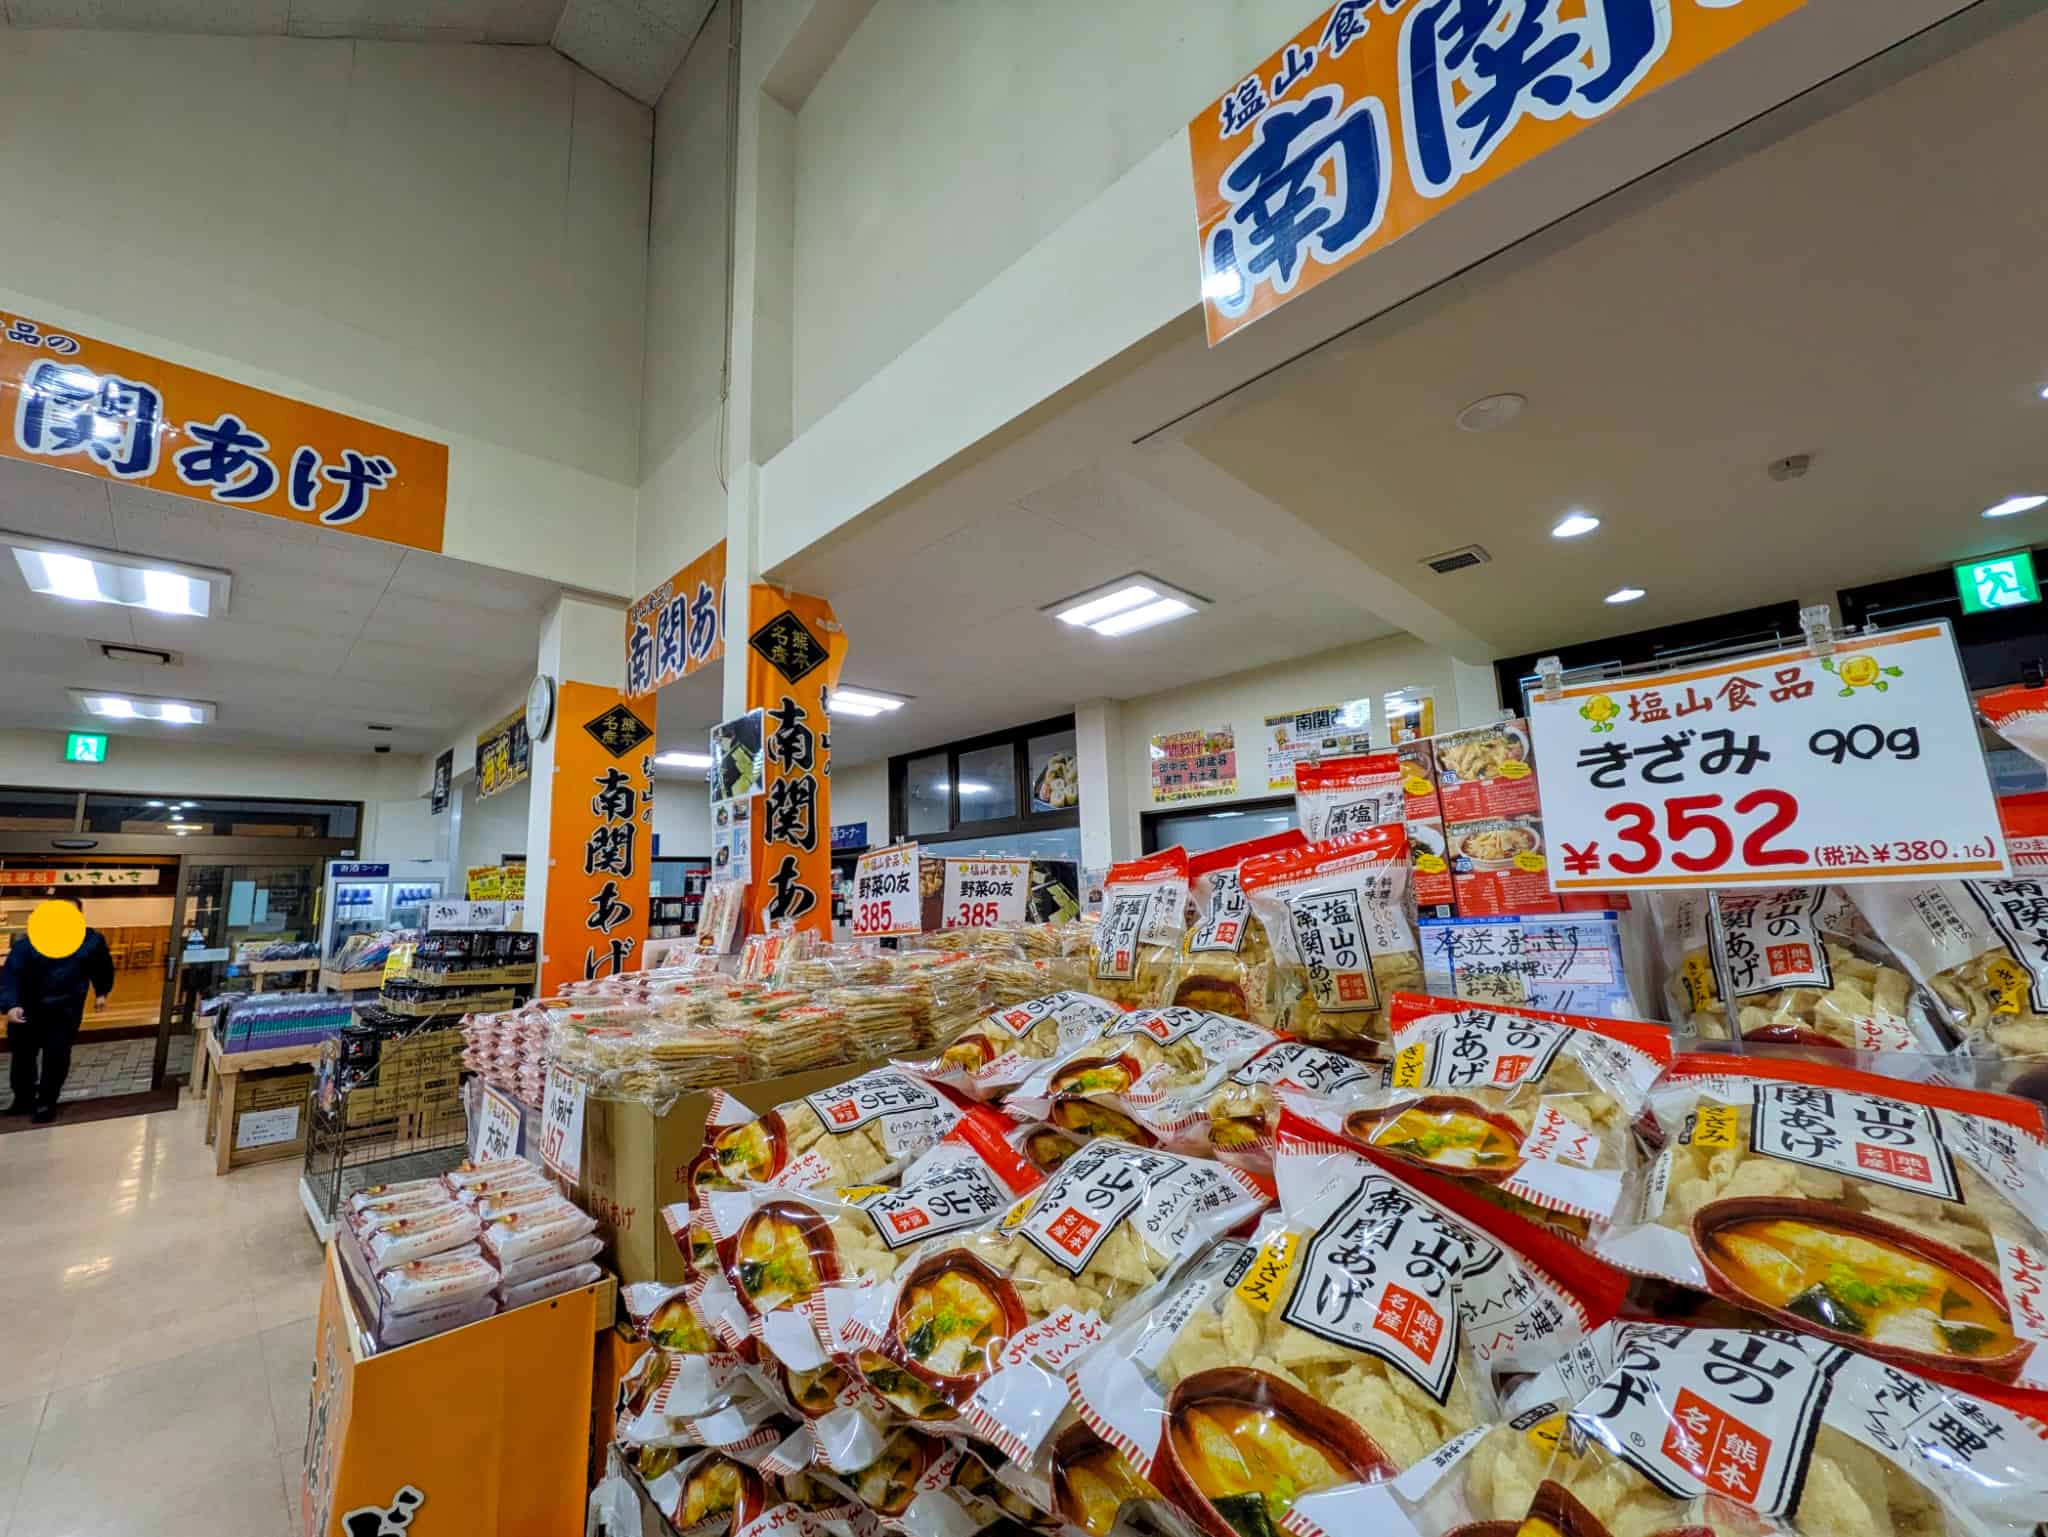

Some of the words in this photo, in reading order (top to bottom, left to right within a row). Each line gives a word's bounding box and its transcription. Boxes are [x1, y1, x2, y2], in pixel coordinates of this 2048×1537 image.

[15, 358, 397, 525] 関あげ
[626, 581, 725, 698] 南関あ
[1628, 667, 1814, 724] 塩山食品
[1577, 728, 1771, 789] きざみ
[1809, 724, 1920, 765] 90g
[1563, 789, 1809, 876] ¥352
[584, 768, 638, 979] 南関あげ
[859, 872, 911, 899] 野菜の友
[960, 880, 1014, 898] 野菜の友
[1293, 903, 1334, 1005] 南関あげ
[1322, 899, 1358, 968] 塩山の
[1316, 1187, 1414, 1325] 南関あげ
[1670, 1405, 1713, 1466] 名産
[1712, 1432, 1758, 1495] 熊本
